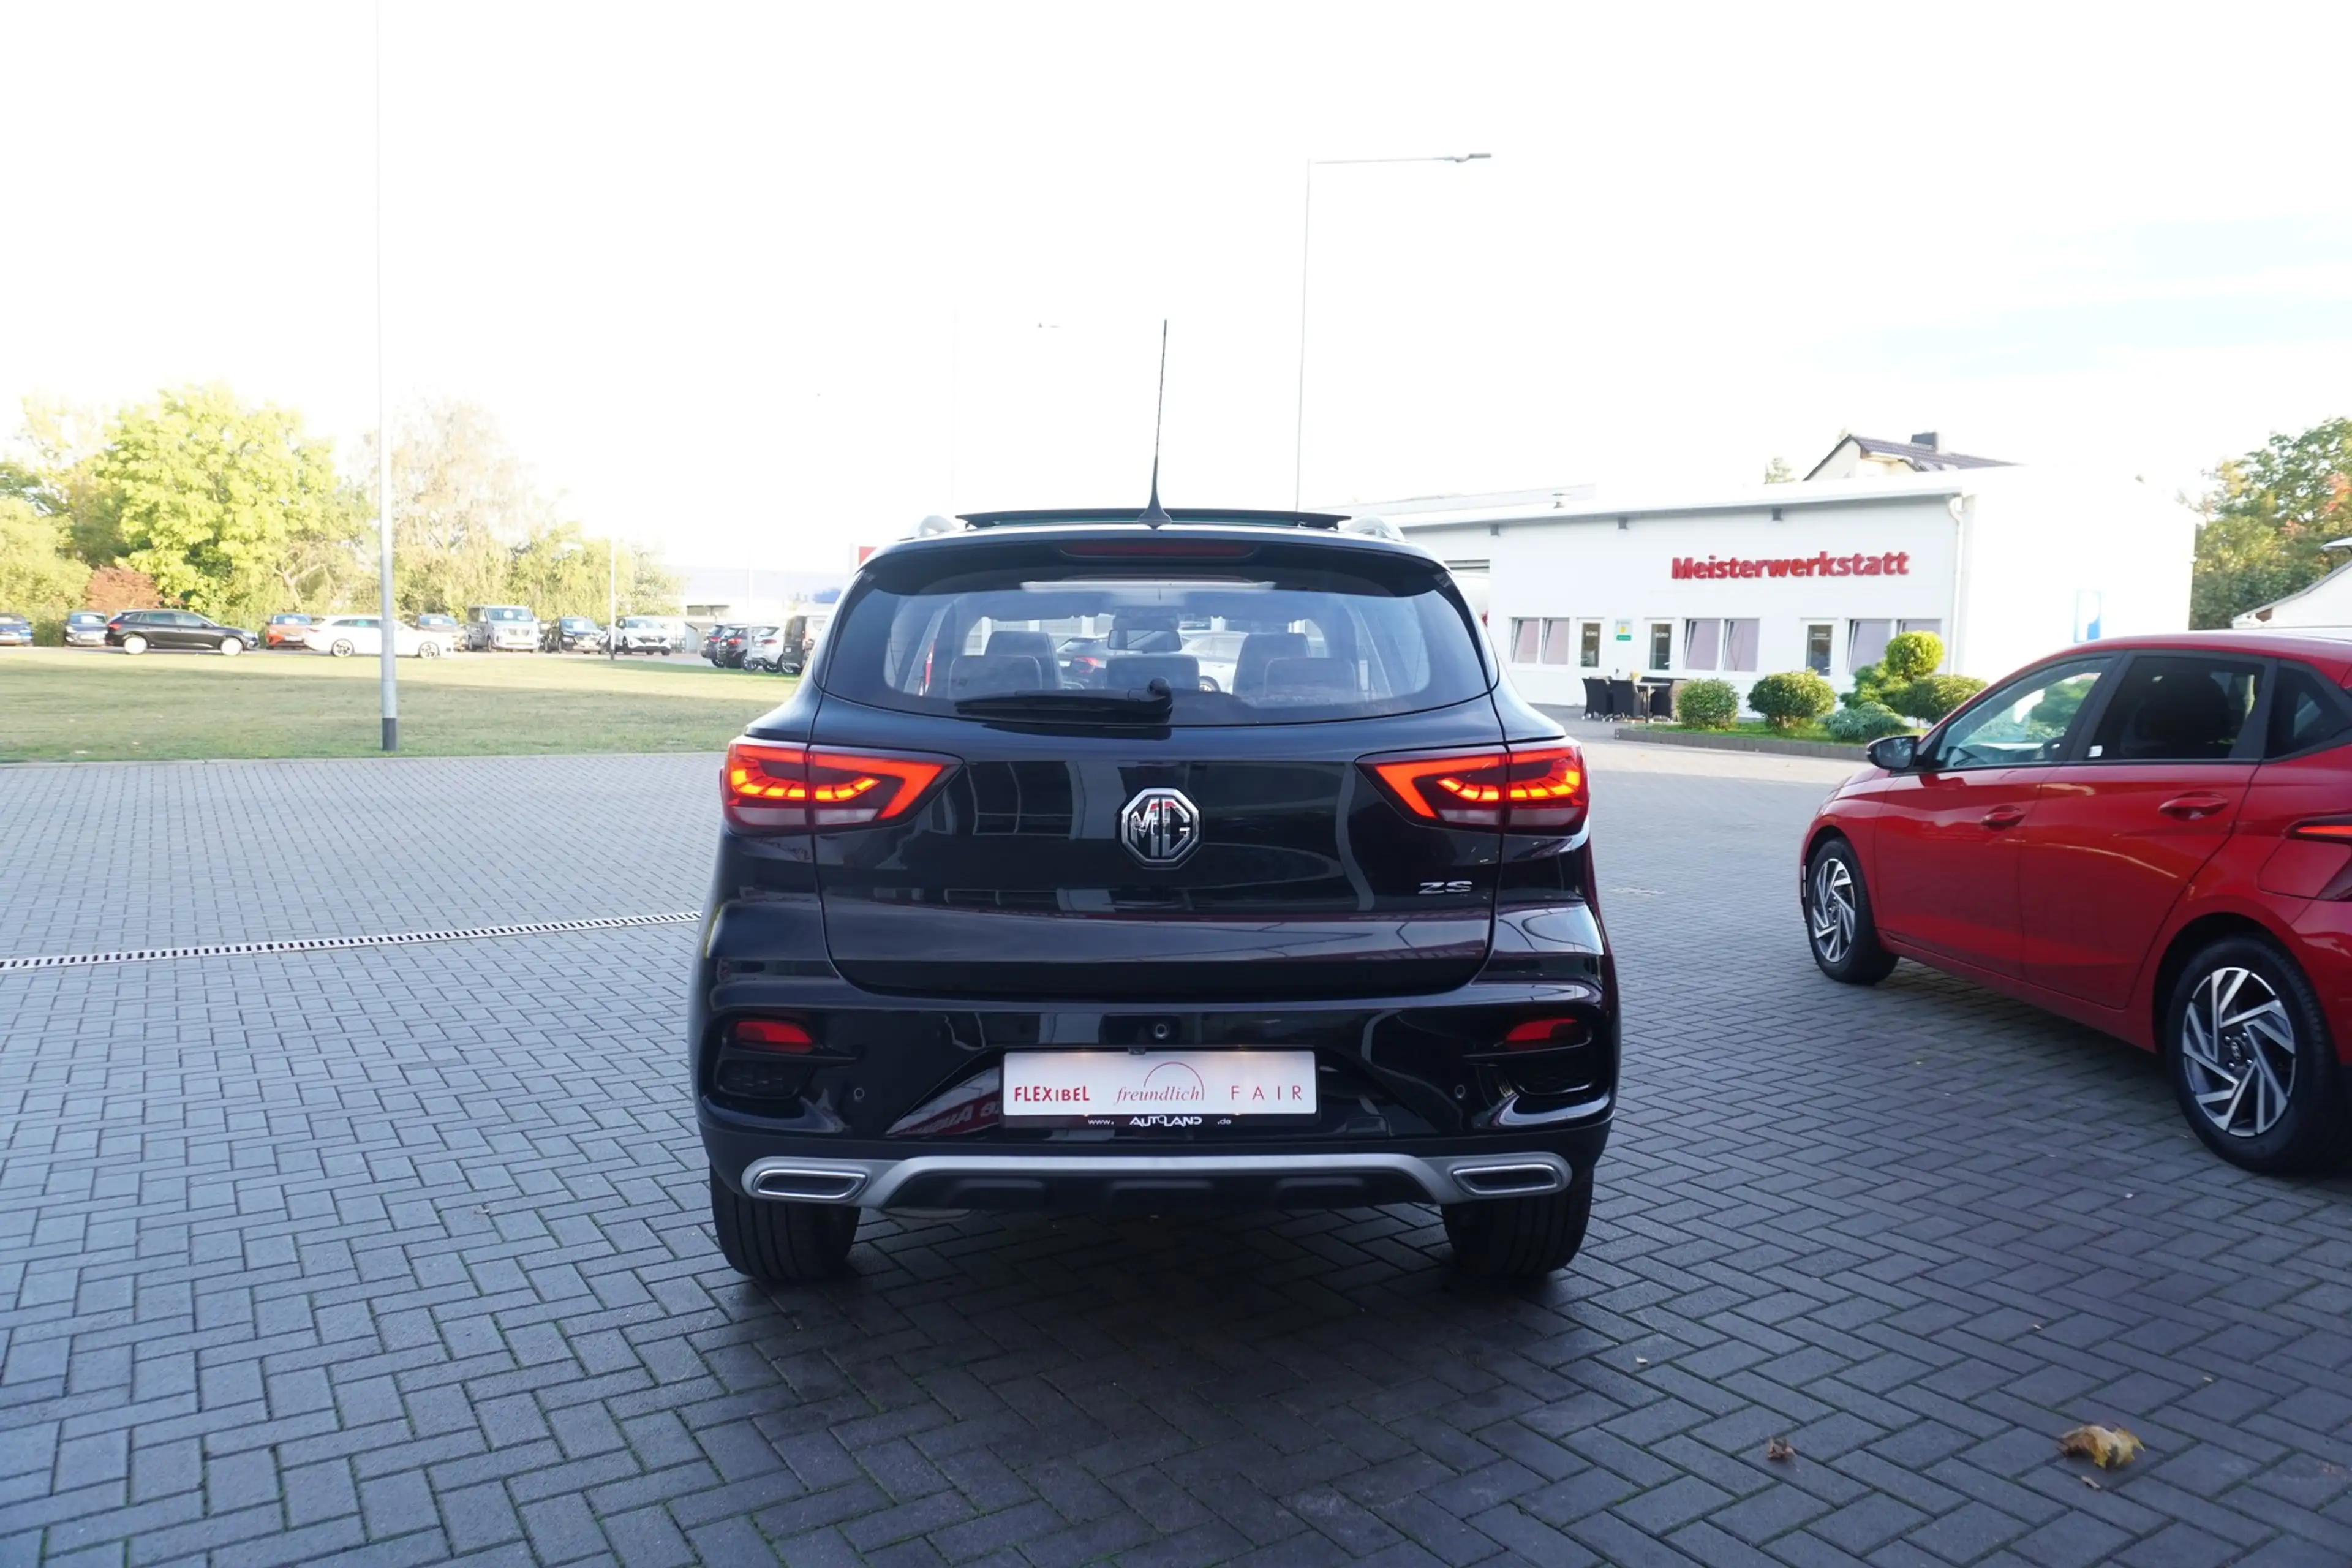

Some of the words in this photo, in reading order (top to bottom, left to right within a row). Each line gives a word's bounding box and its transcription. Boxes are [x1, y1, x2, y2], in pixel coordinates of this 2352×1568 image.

[1671, 551, 1910, 579] Meisterwerkstatt
[1130, 797, 1191, 858] MG
[1418, 880, 1472, 894] ZS
[1014, 1085, 1090, 1102] FLEXIBEL
[1114, 1085, 1199, 1106] freundlich
[1231, 1085, 1302, 1101] FAIR
[1129, 1114, 1203, 1128] AUTOLAND
